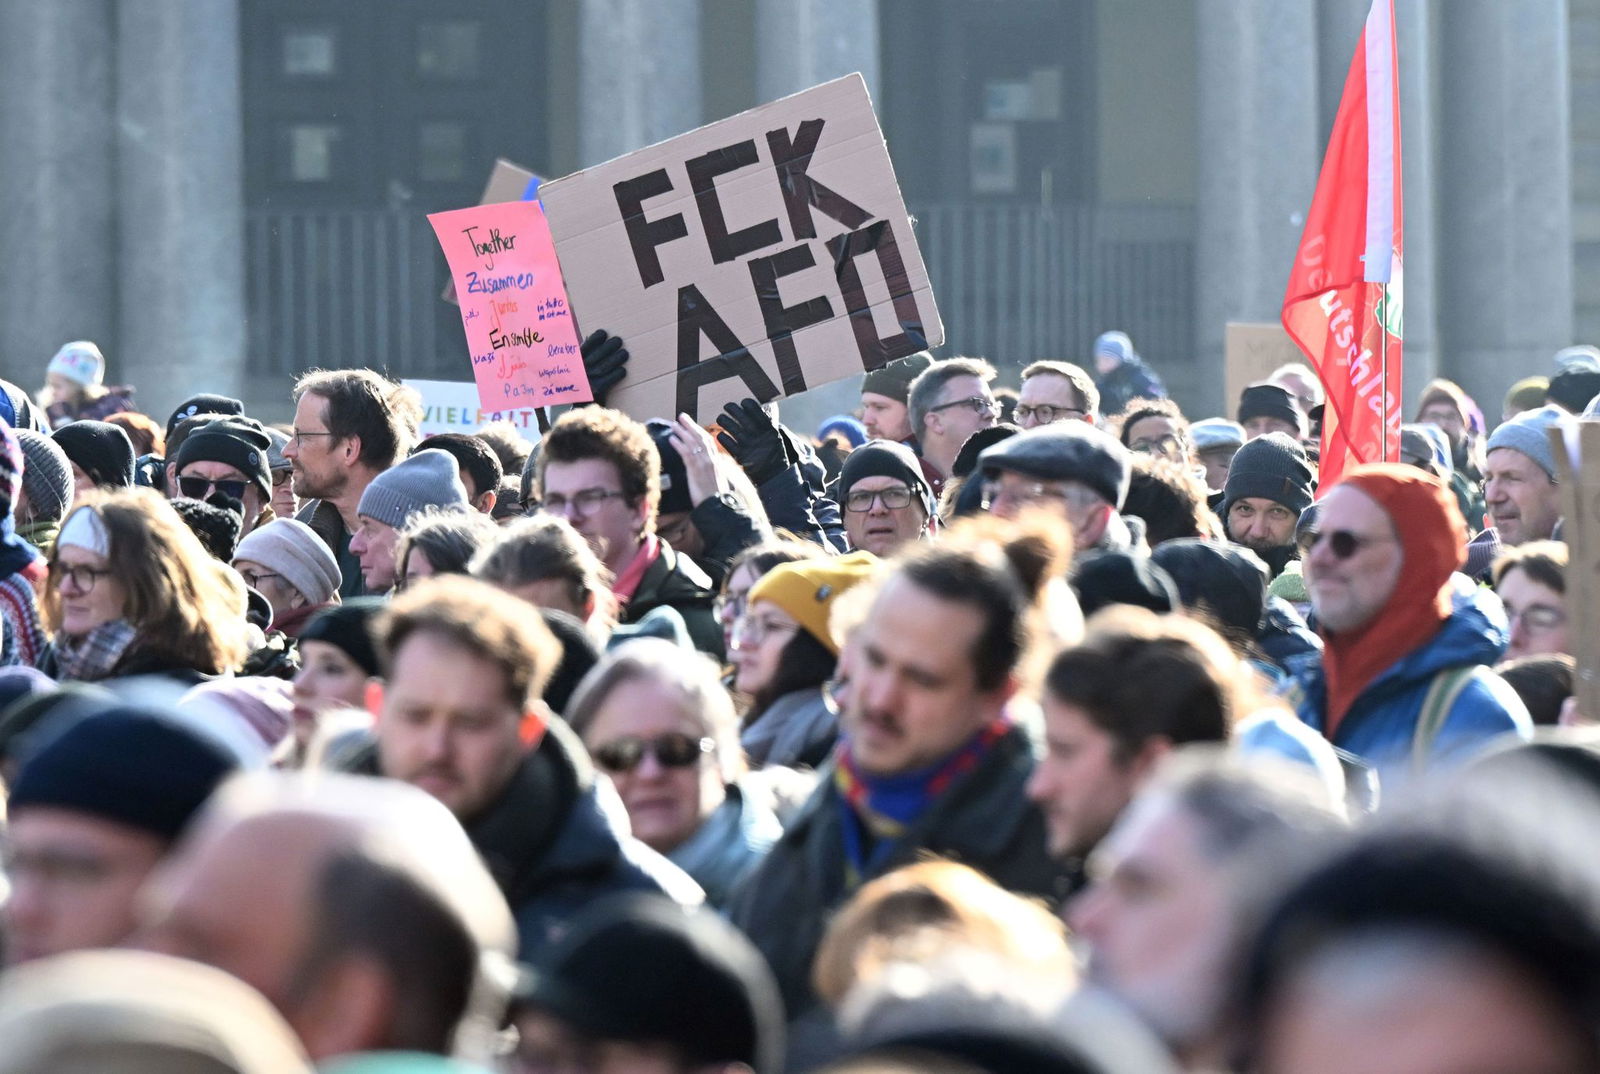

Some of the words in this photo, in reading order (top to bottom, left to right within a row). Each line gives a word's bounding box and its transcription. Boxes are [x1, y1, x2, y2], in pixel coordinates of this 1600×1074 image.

[613, 118, 875, 288] FCK
[462, 226, 517, 271] Together
[466, 271, 534, 294] Zusammen
[676, 220, 929, 420] AFD
[423, 405, 533, 428] VIELFALT
